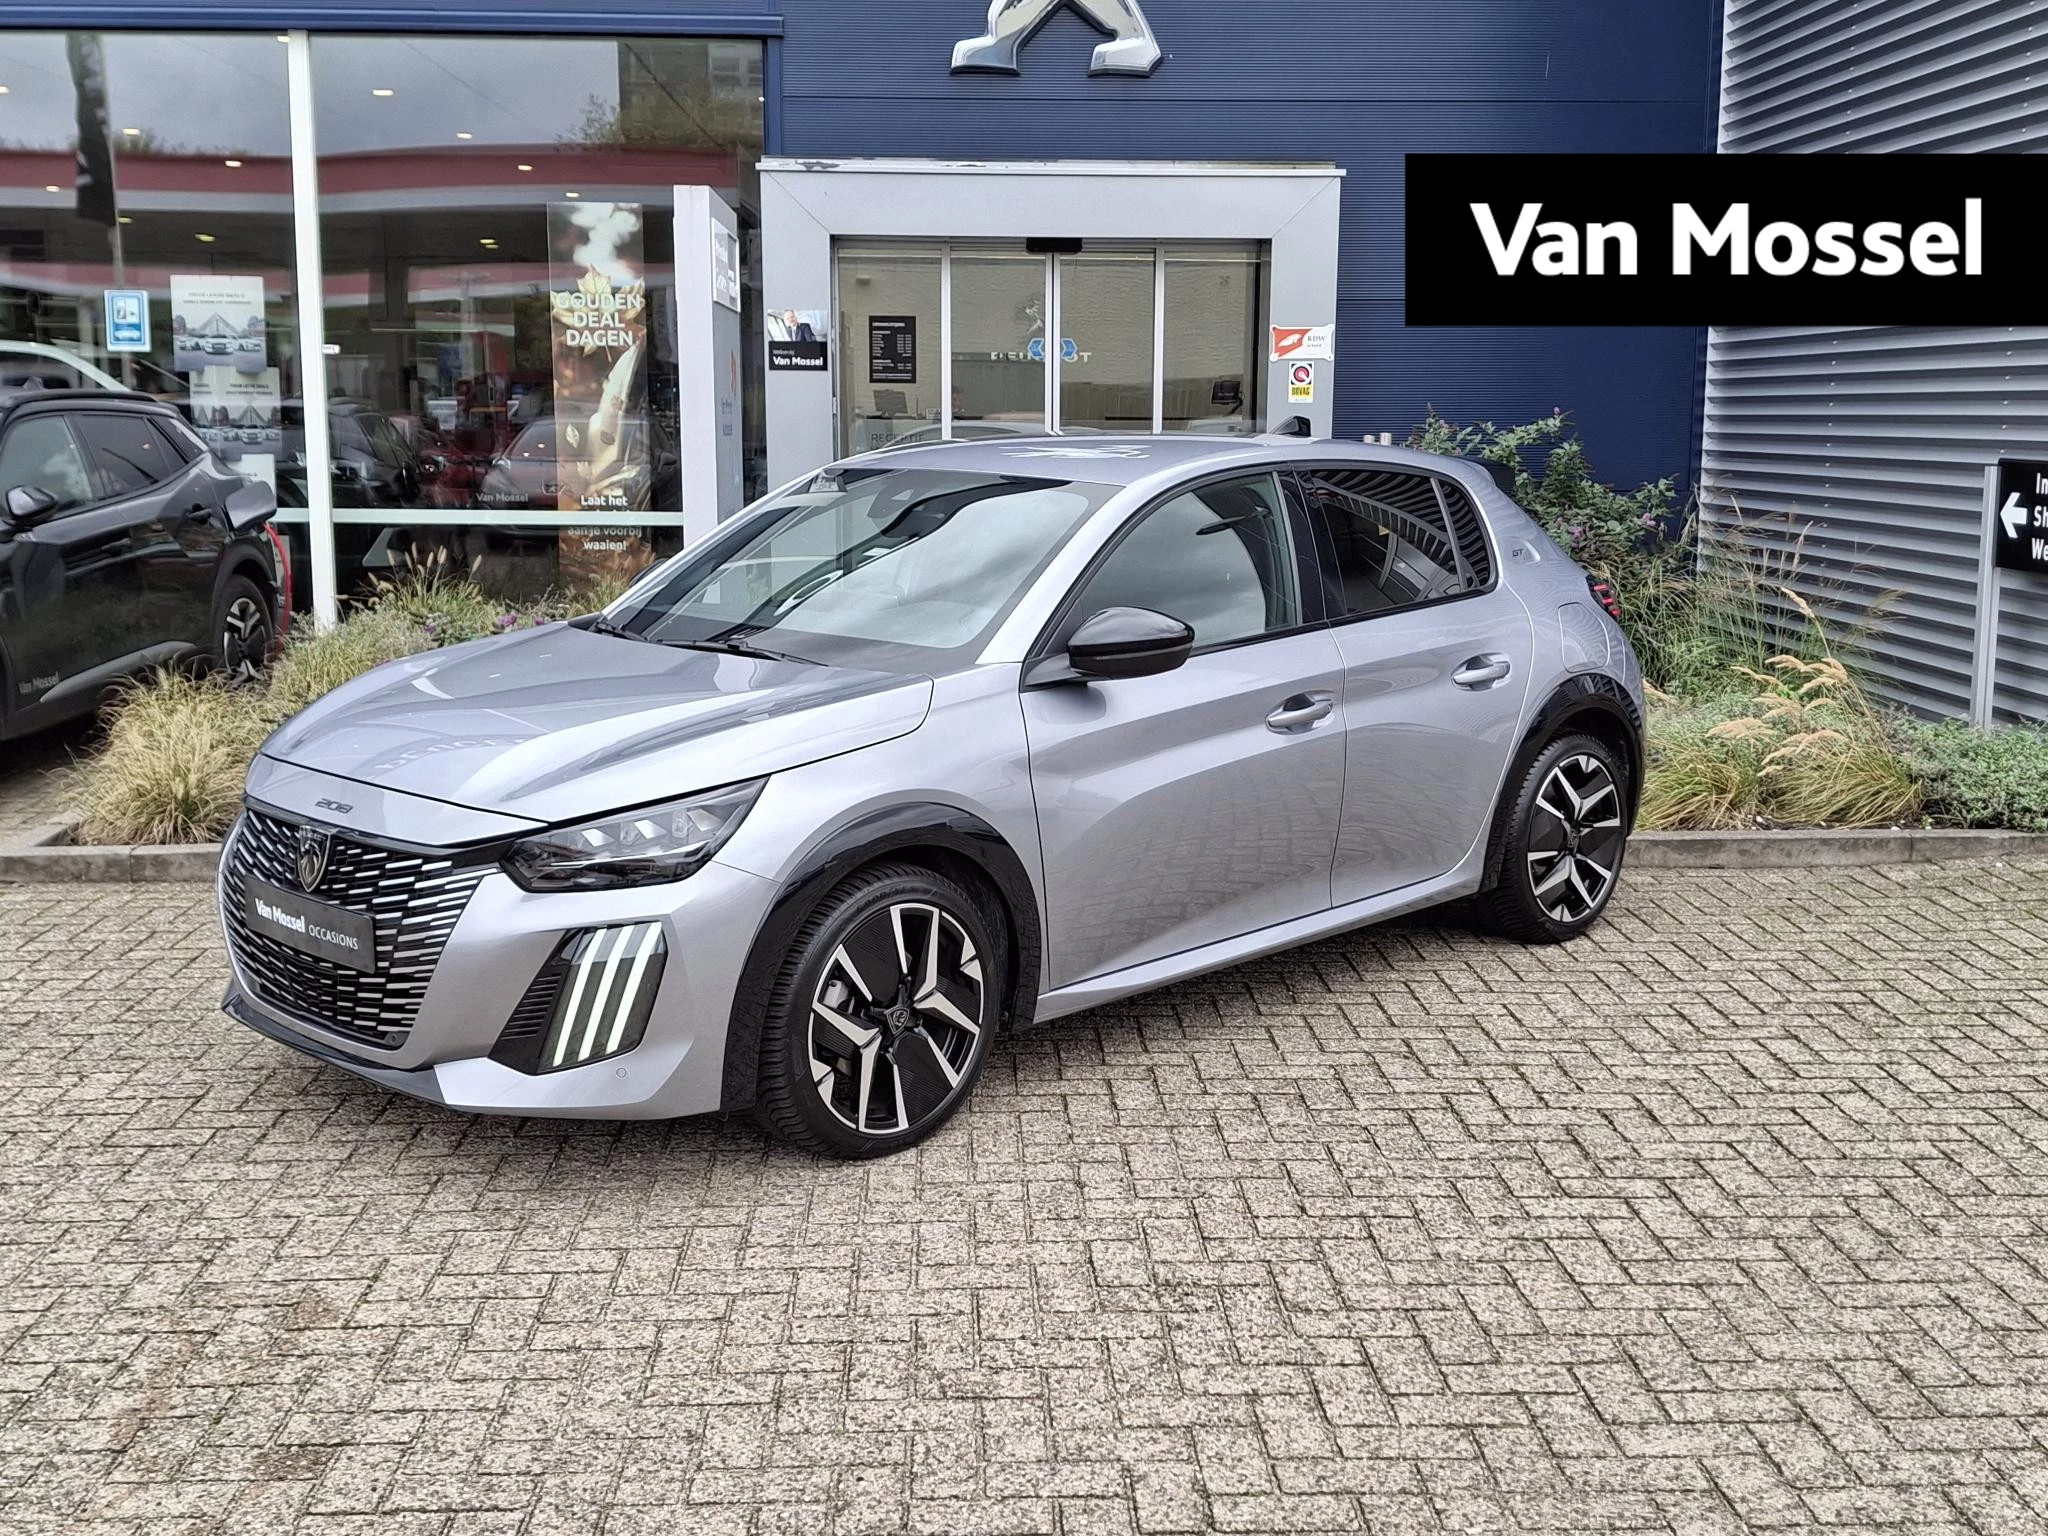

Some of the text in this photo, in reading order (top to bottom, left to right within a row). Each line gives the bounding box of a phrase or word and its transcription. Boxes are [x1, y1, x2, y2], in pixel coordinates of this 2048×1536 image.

[556, 293, 641, 309] GOUDEN
[573, 312, 625, 328] DEAL
[566, 330, 633, 346] DAGEN
[773, 356, 823, 366] Van Mossel
[475, 492, 529, 502] Van Mossel
[580, 495, 628, 506] Laat het
[568, 527, 588, 536] aan
[603, 526, 643, 538] voorbij
[583, 540, 627, 551] waaien!
[315, 798, 354, 815] 208
[255, 897, 360, 950] Van Mossel OCCASIONS
